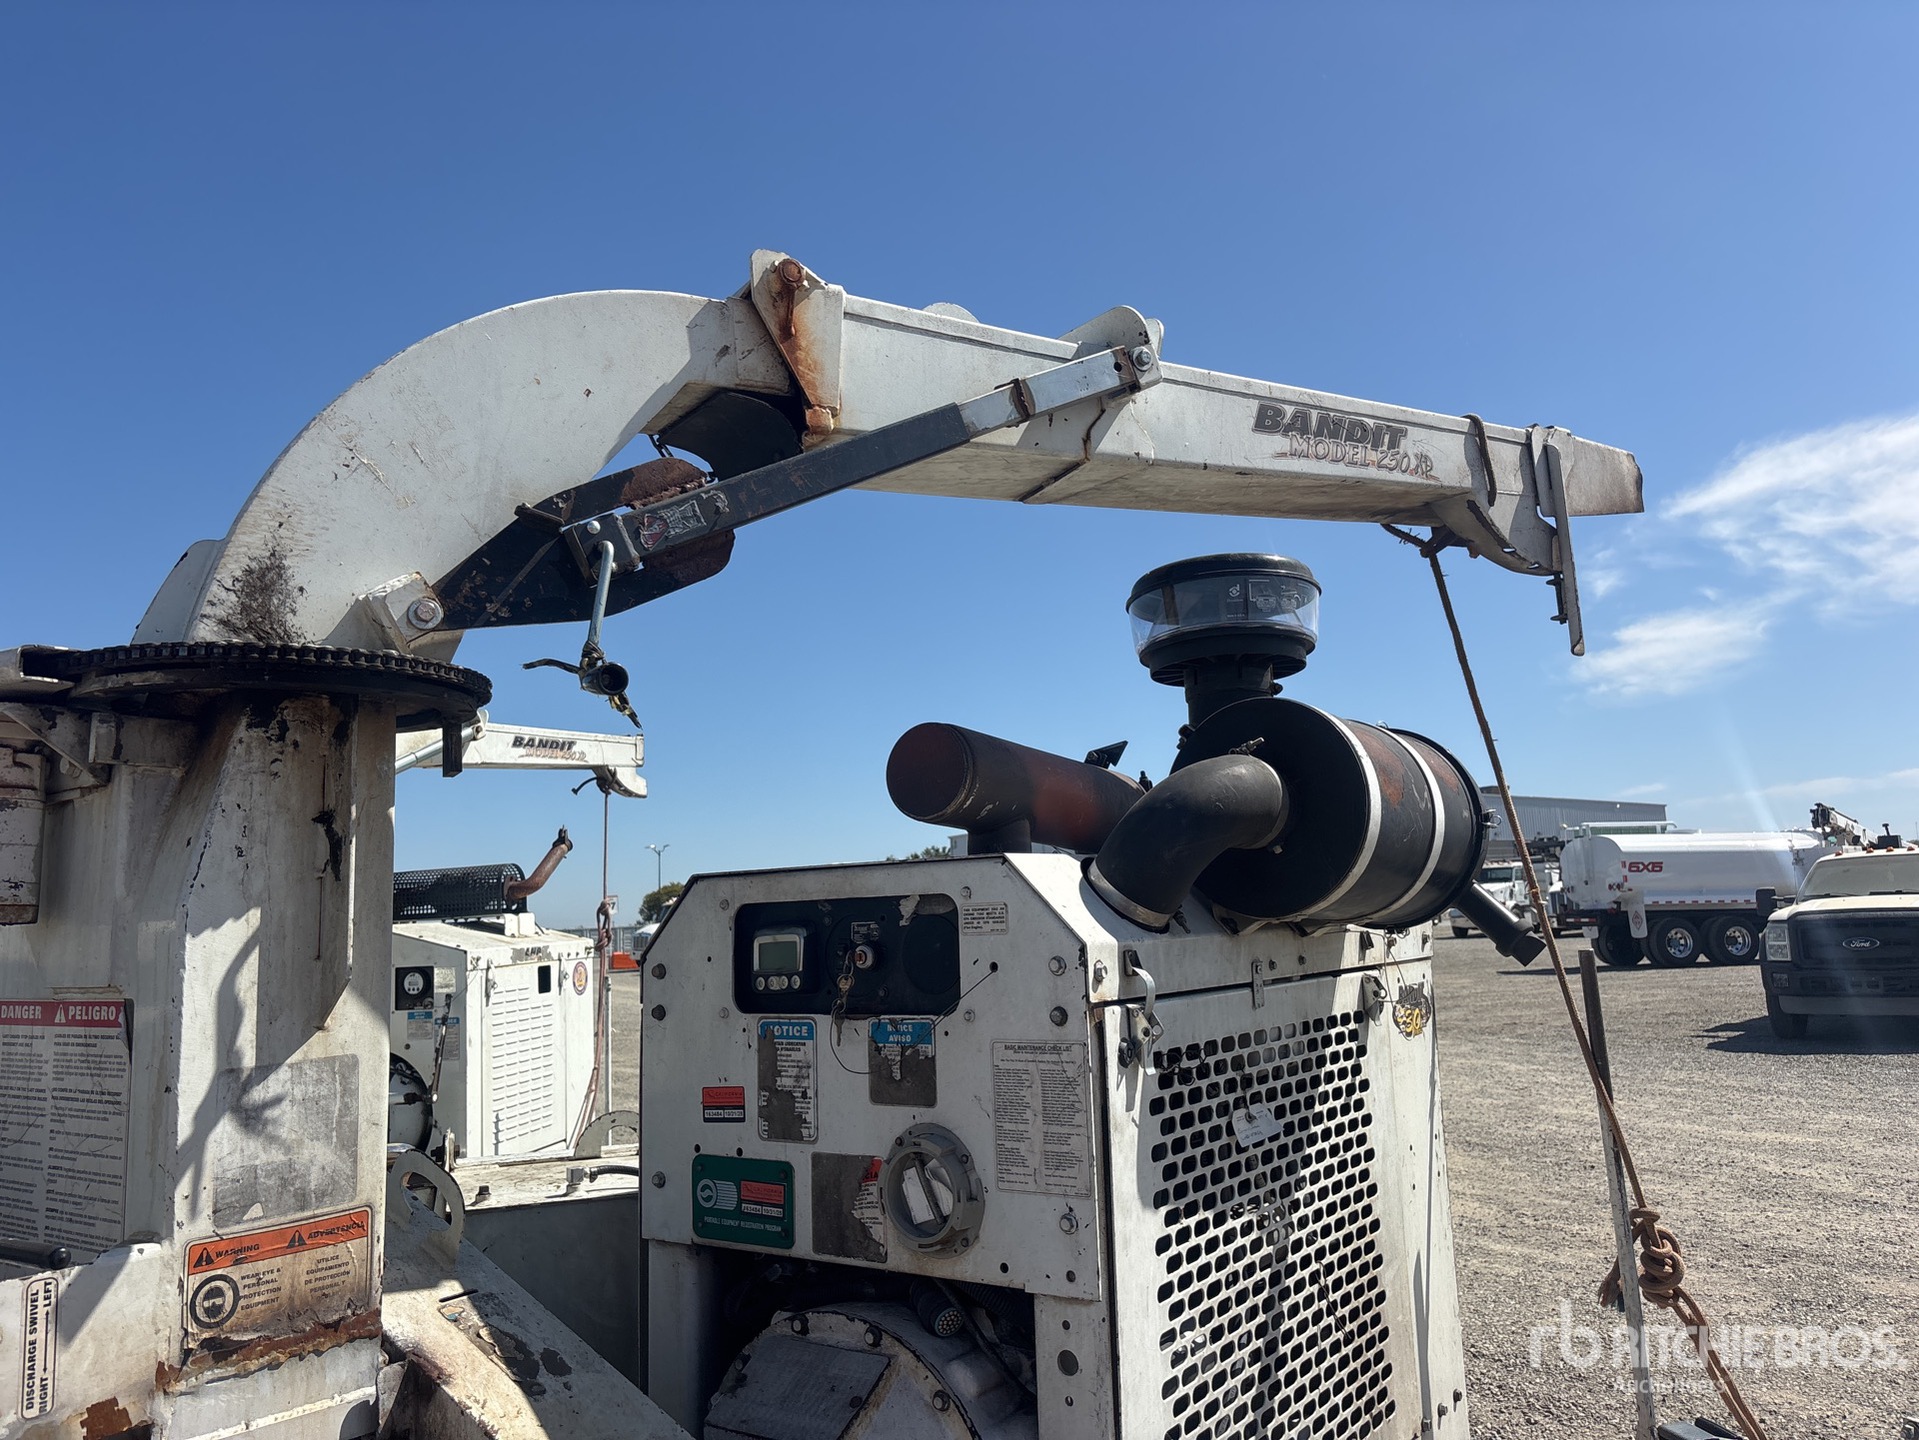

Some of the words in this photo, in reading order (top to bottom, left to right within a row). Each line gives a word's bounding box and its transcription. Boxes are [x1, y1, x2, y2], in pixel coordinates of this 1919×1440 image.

[1252, 401, 1408, 450] BANDIT
[1289, 433, 1371, 467] MODEL
[512, 736, 577, 751] BANDIT
[525, 748, 560, 759] MODEL
[1628, 861, 1664, 873] 6X6
[1, 1005, 42, 1019] DANGER
[68, 1006, 116, 1020] PELIGRO
[215, 1243, 260, 1259] WARNING
[317, 1254, 340, 1264] UTILICE
[241, 1271, 260, 1281] WEAR
[262, 1268, 276, 1277] EYE
[306, 1261, 350, 1275] EQUIPAMIENTO
[314, 1269, 351, 1283] PROTECCIÓN
[243, 1278, 278, 1290] PERSONAL
[43, 1281, 52, 1308] LEFT
[240, 1286, 282, 1301] PROTECTION
[240, 1297, 280, 1311] EQUIPMENT
[29, 1289, 39, 1336] SWIVEL
[26, 1338, 37, 1411] DISCHARGE
[39, 1377, 48, 1414] RIGHT
